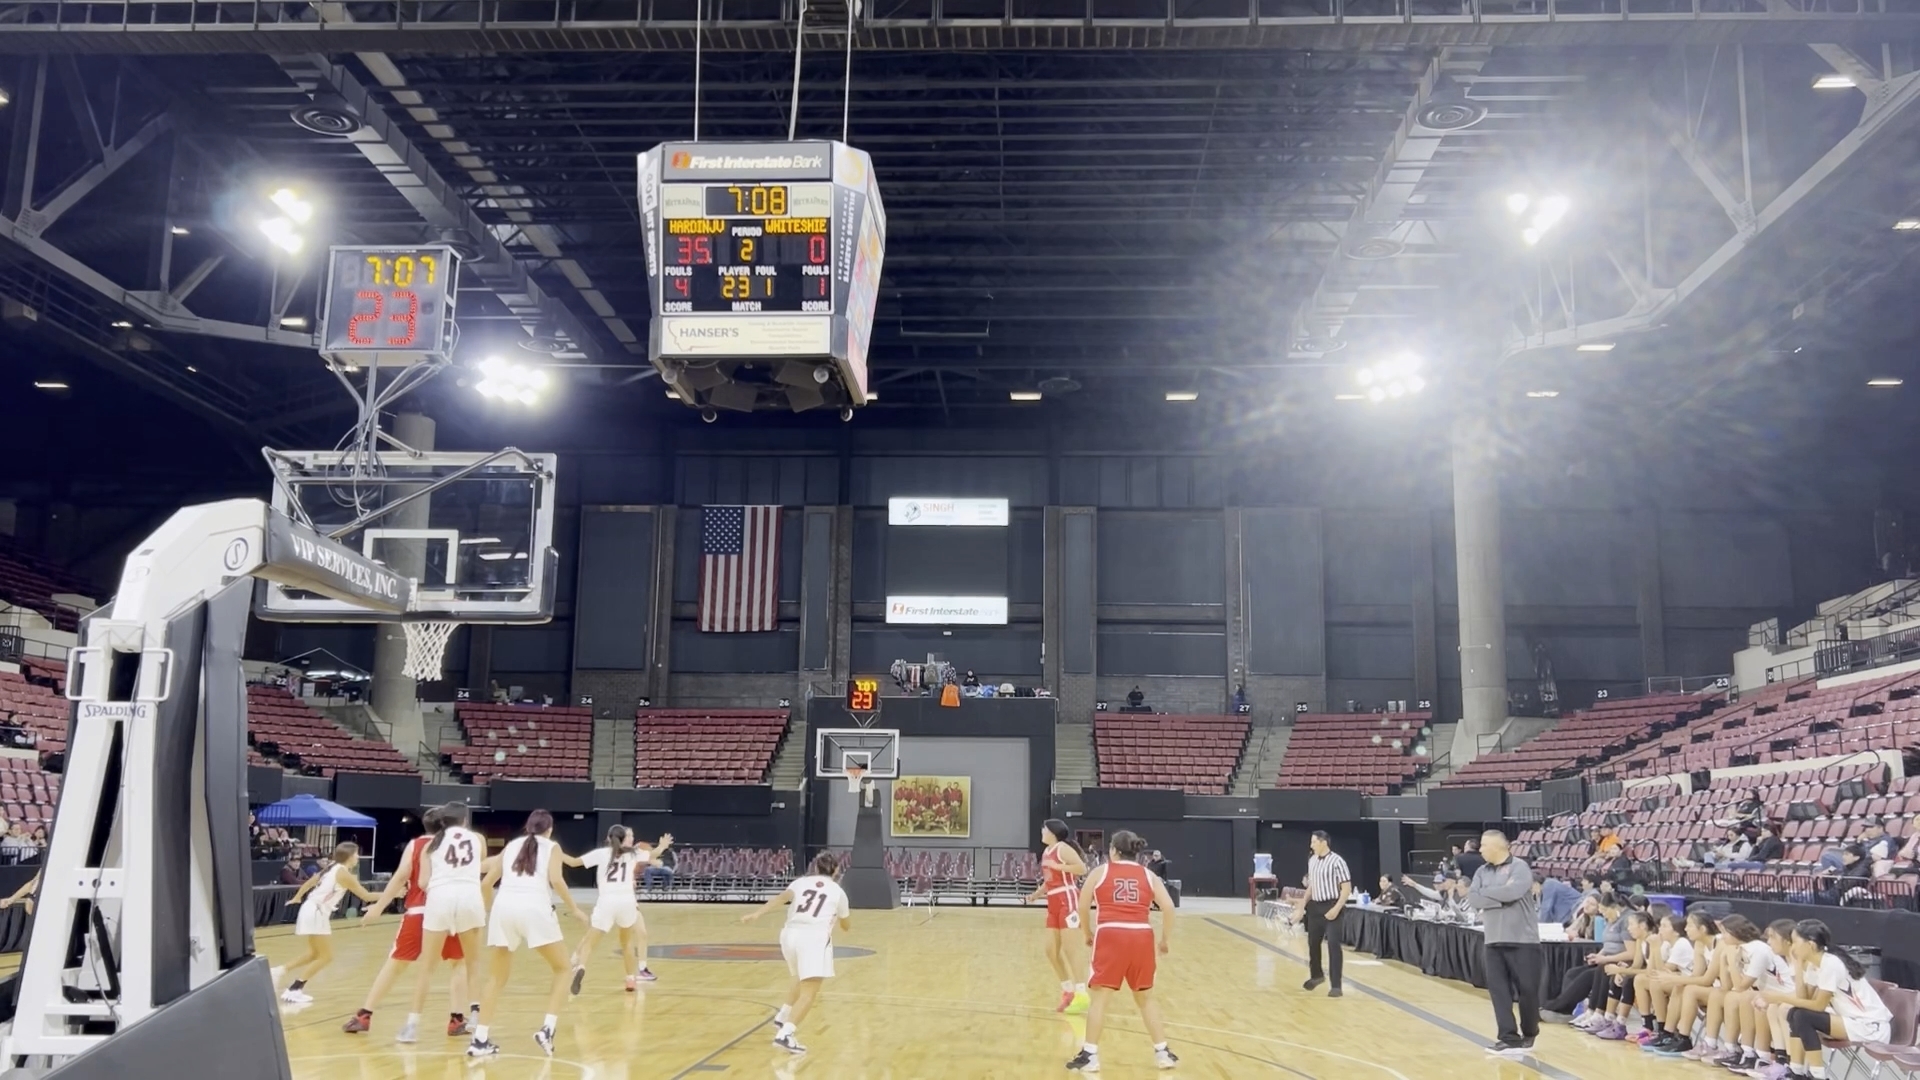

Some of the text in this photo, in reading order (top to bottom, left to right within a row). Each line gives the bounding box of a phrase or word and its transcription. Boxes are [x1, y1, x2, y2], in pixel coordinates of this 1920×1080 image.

[690, 154, 822, 169] First Interstate Bank
[728, 187, 785, 215] 7:08
[732, 226, 762, 237] PERIOD
[678, 236, 711, 264] 35
[740, 239, 753, 261] 2
[809, 236, 826, 263] 0
[366, 256, 436, 288] 7:07
[665, 265, 692, 276] FOULS
[718, 265, 777, 276] PLAYER FOUL
[802, 264, 829, 275] FOULS
[674, 278, 688, 297] 4
[722, 277, 750, 298] 23
[765, 278, 772, 296] 1
[665, 301, 692, 312] SCORE
[732, 301, 762, 311] MATCH
[802, 301, 829, 311] SCORE
[347, 291, 417, 345] 23
[679, 327, 739, 338] HANSER'S
[923, 503, 954, 512] SINGH
[290, 533, 398, 599] VIP SERVICES, INC.
[905, 606, 929, 616] First
[930, 606, 979, 616] Interstate
[1716, 678, 1729, 686] 23
[852, 692, 873, 710] 23
[1597, 690, 1608, 698] 23
[84, 704, 147, 718] SPALDING
[444, 839, 473, 868] 43
[607, 861, 627, 883] 21
[1113, 878, 1140, 903] 25
[797, 889, 828, 918] 31
